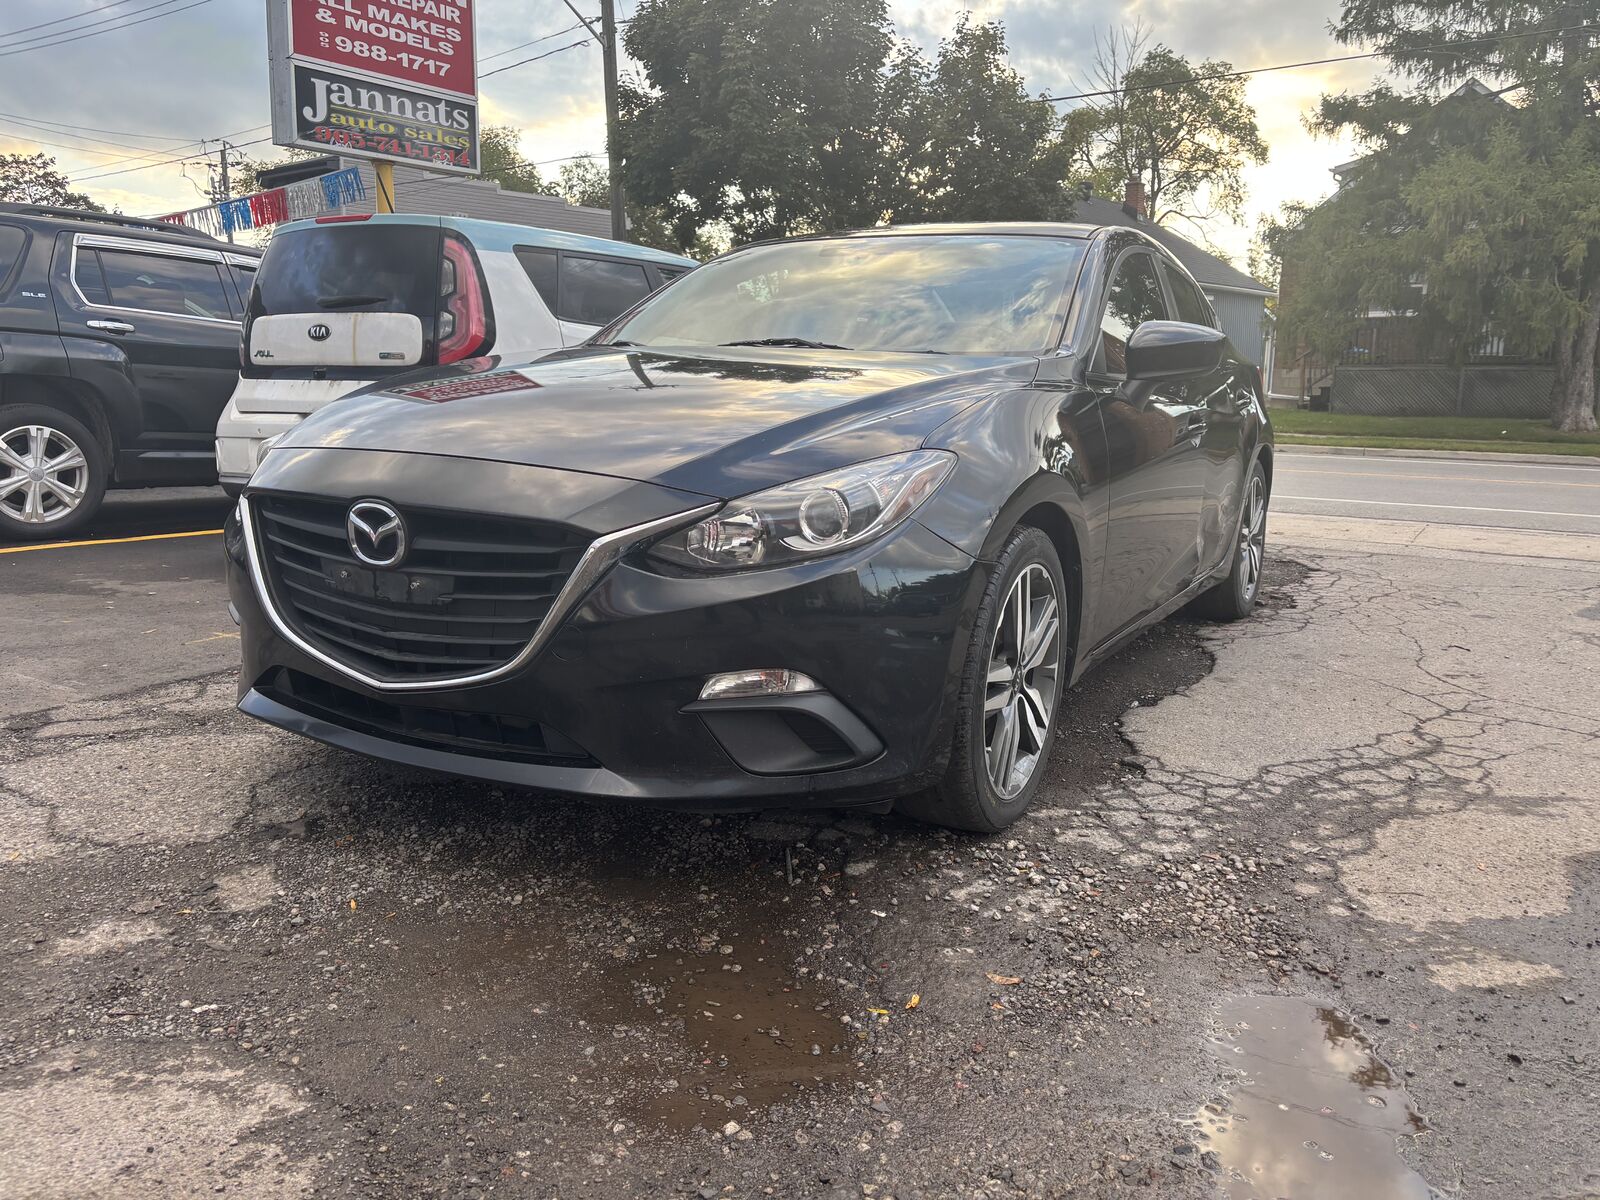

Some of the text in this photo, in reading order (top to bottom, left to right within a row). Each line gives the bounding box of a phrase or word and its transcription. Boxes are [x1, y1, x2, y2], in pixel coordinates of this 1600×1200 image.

[314, 8, 455, 56] & MODELS
[367, 4, 462, 42] MAKES
[335, 36, 451, 74] 988-1717
[302, 78, 469, 130] Jannats
[330, 112, 470, 148] auto sales
[310, 326, 326, 336] KIA
